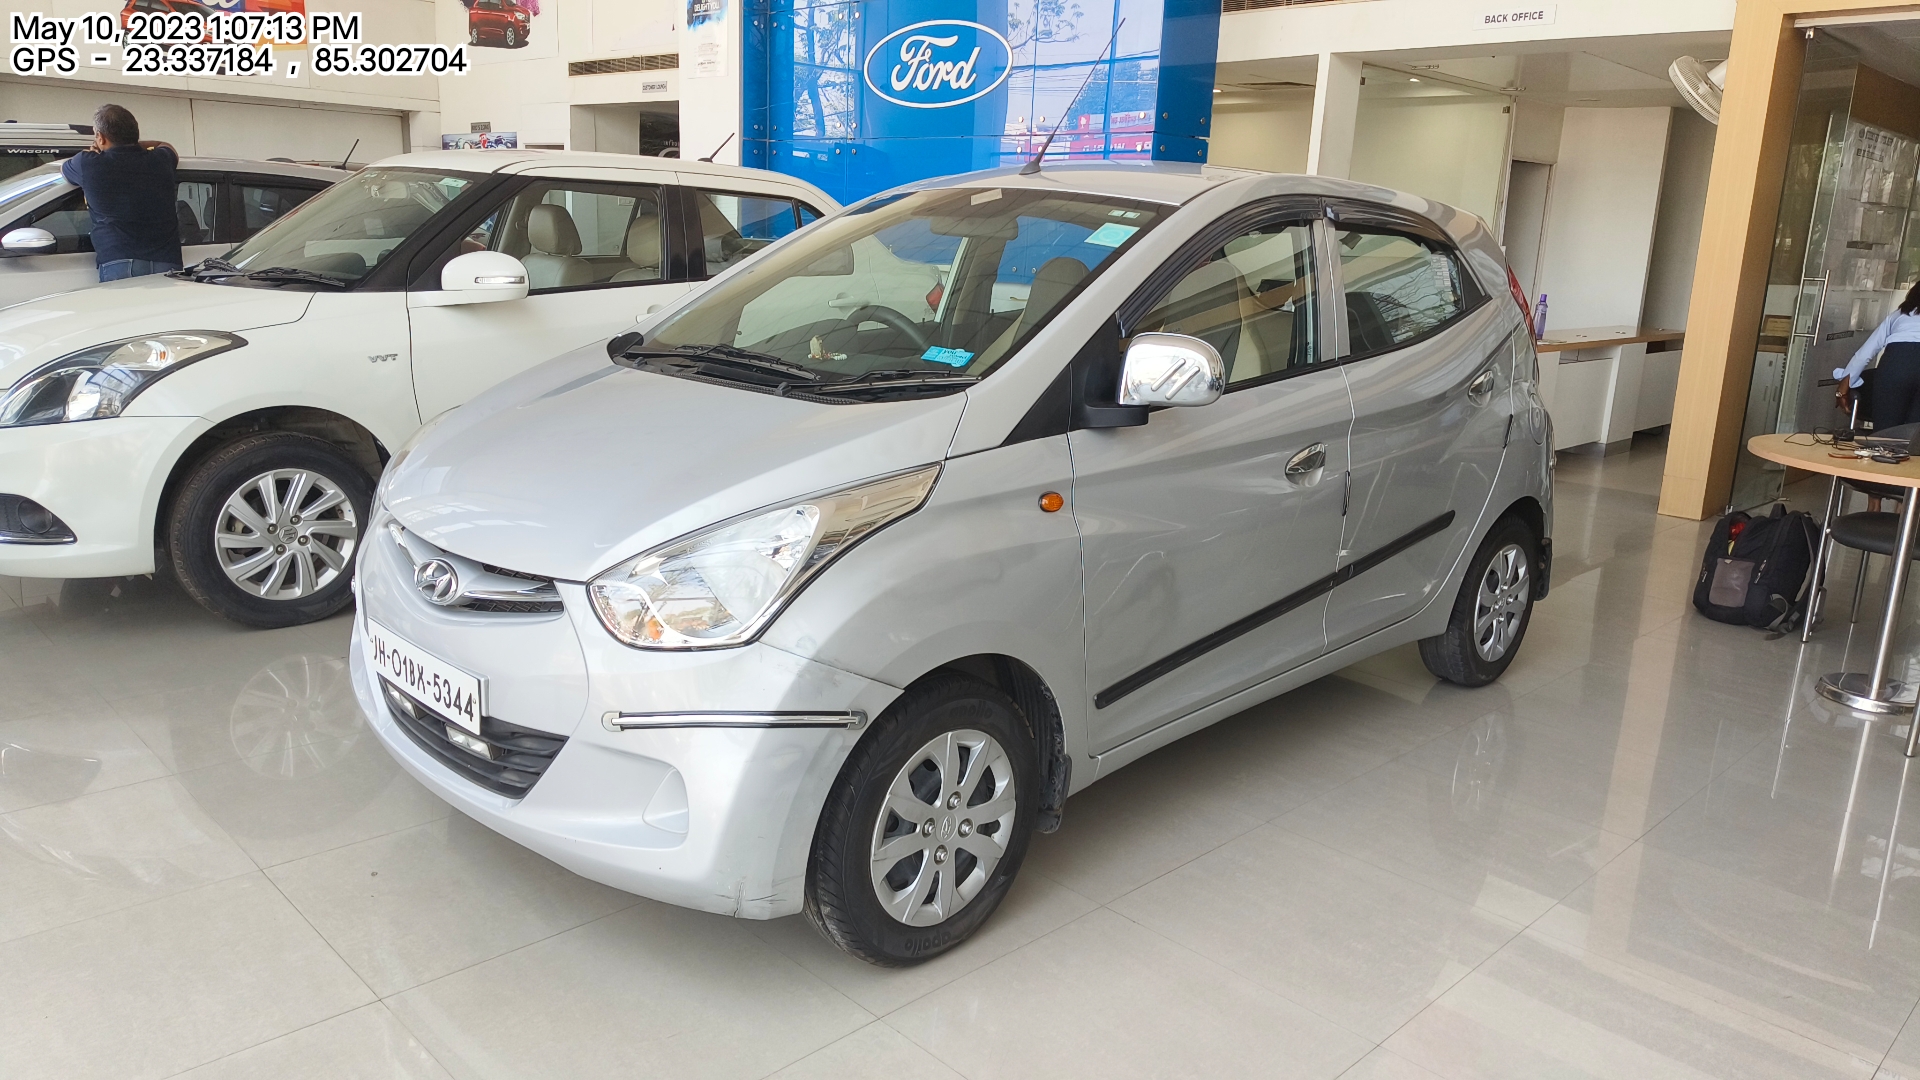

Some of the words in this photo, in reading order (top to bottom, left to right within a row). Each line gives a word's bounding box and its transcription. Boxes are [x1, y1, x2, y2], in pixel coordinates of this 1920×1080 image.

[1484, 13, 1509, 24] BACK
[1511, 11, 1544, 22] OFFICE
[890, 34, 981, 92] Ford
[367, 353, 398, 363] VVT
